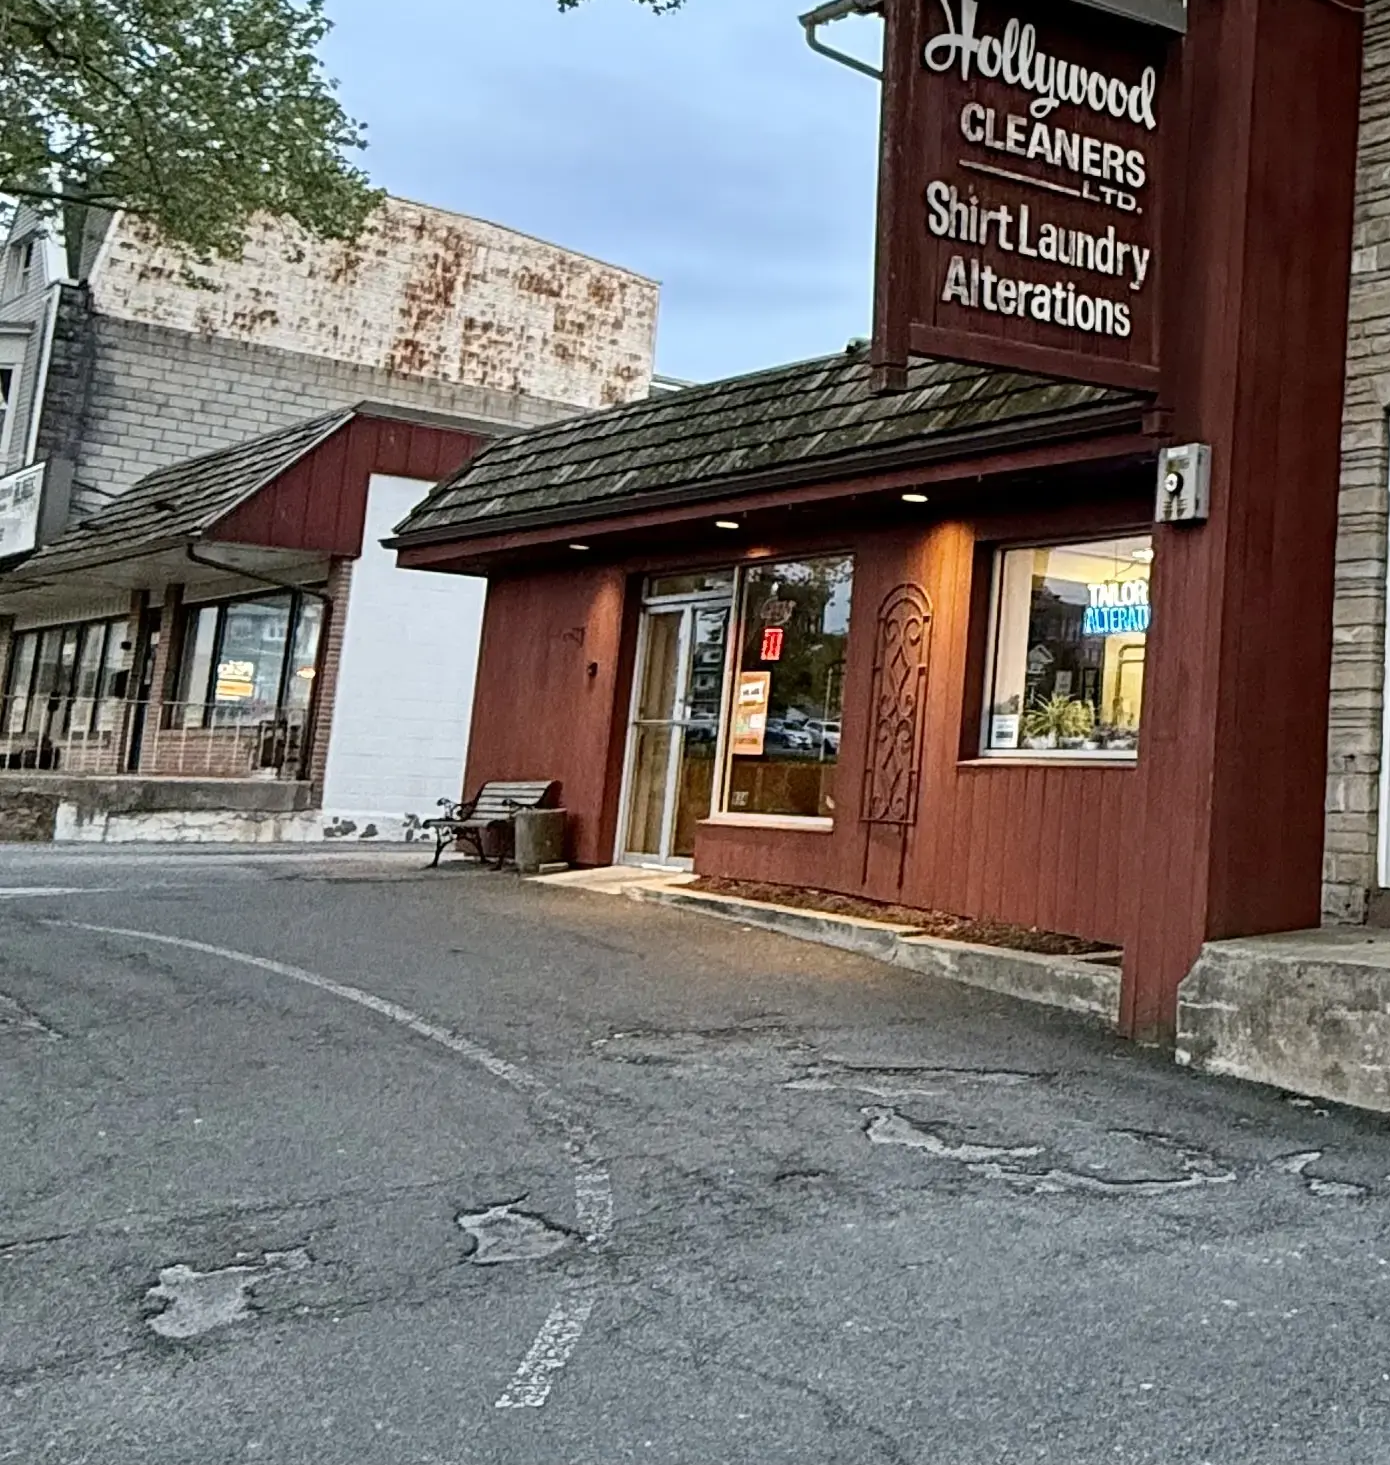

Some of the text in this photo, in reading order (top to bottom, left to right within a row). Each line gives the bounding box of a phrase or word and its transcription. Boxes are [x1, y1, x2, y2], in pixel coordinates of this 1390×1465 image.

[960, 102, 1147, 189] CLEANERS
[926, 180, 1151, 291] Shirt Laundry
[1081, 181, 1144, 215] LTD.
[940, 254, 1132, 338] Alterations
[1087, 579, 1149, 609] TAILOR
